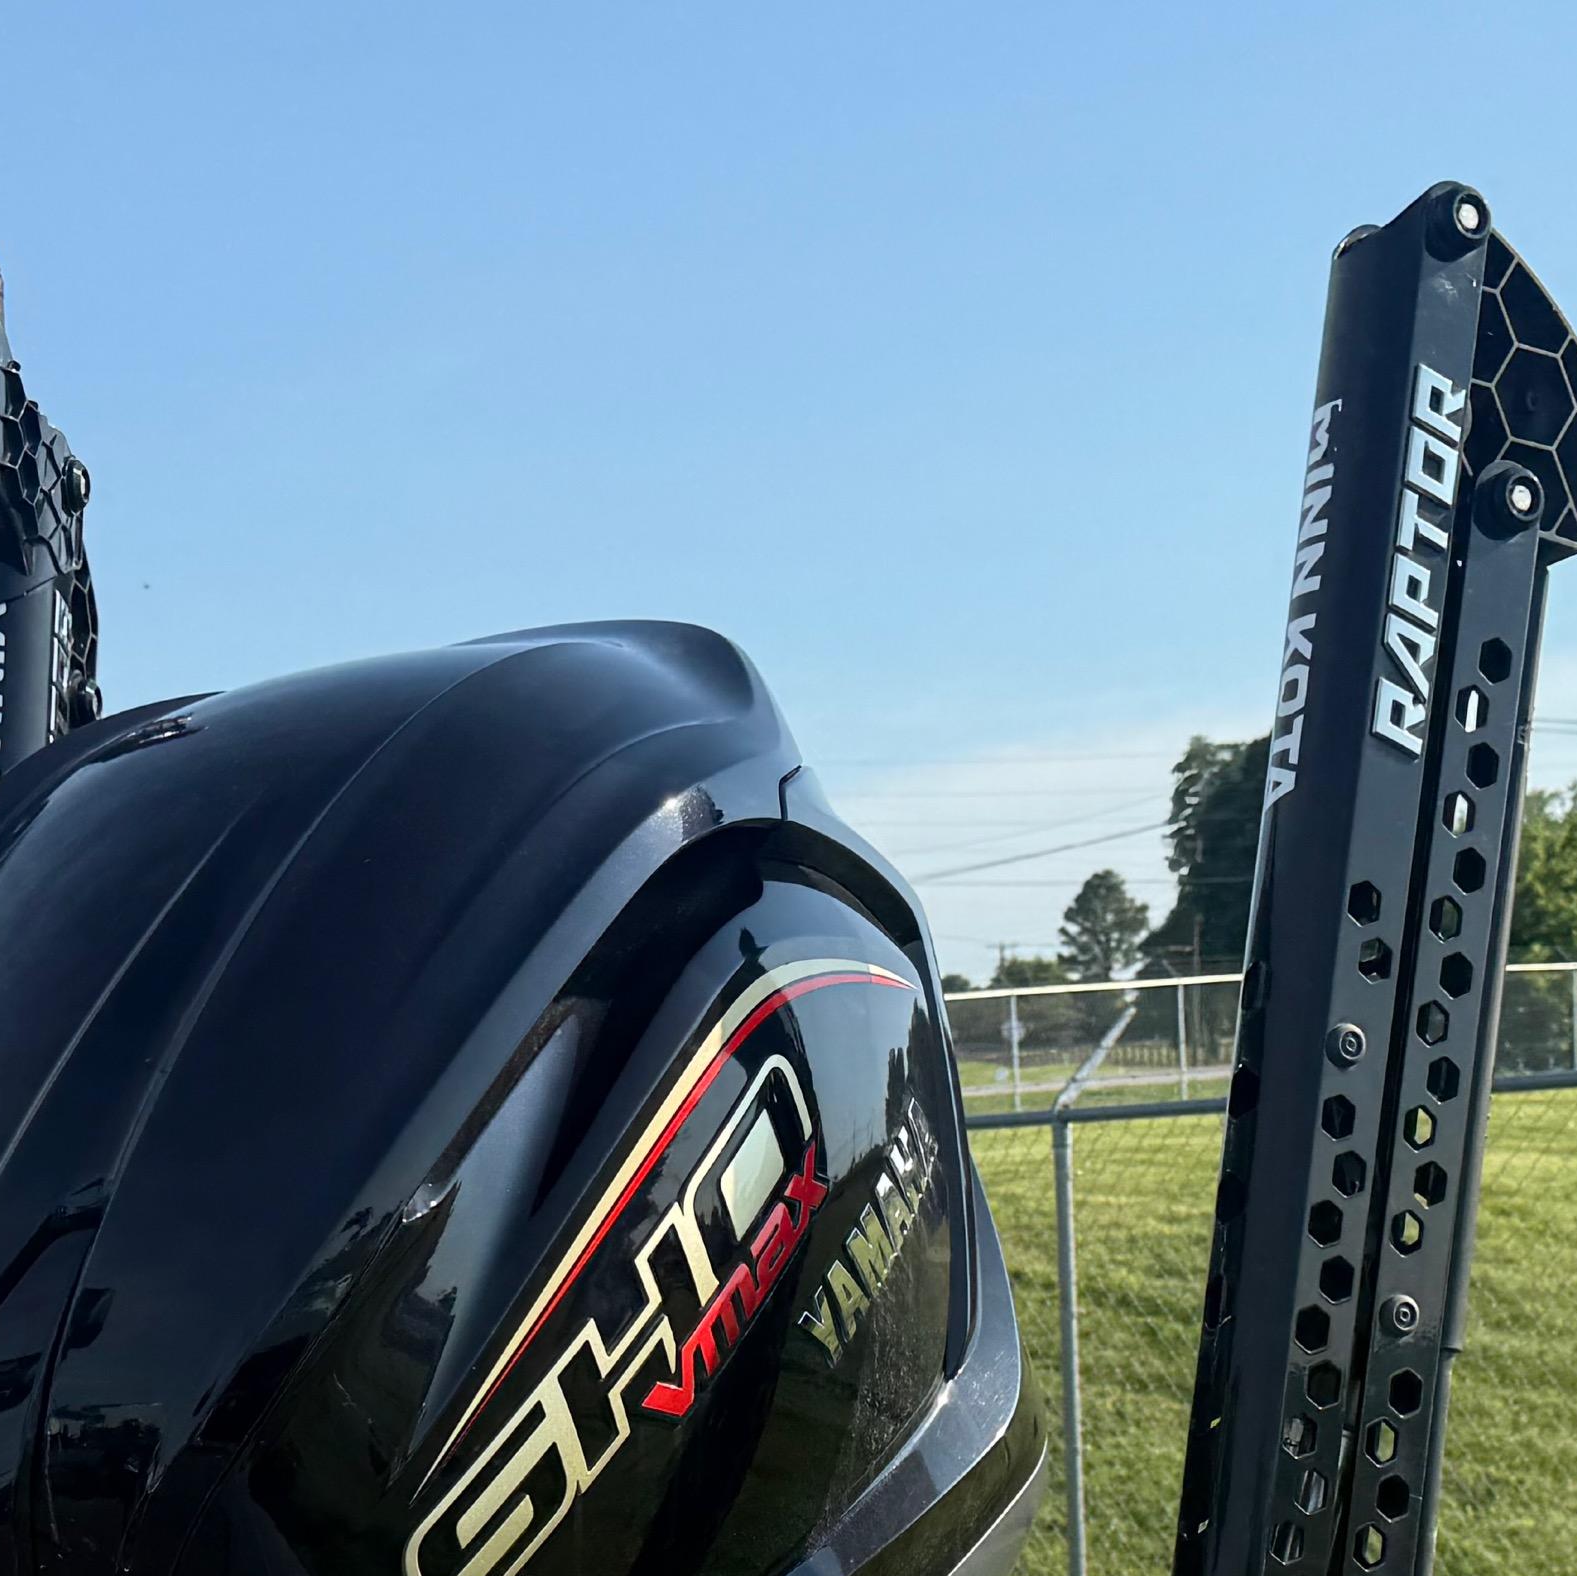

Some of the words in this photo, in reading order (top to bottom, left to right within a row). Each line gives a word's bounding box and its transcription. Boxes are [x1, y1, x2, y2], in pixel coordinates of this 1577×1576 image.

[1291, 398, 1343, 601] MINN
[1370, 361, 1467, 762] RAPTOR
[1262, 613, 1317, 814] KOTA
[796, 1096, 939, 1370] YAMAHA
